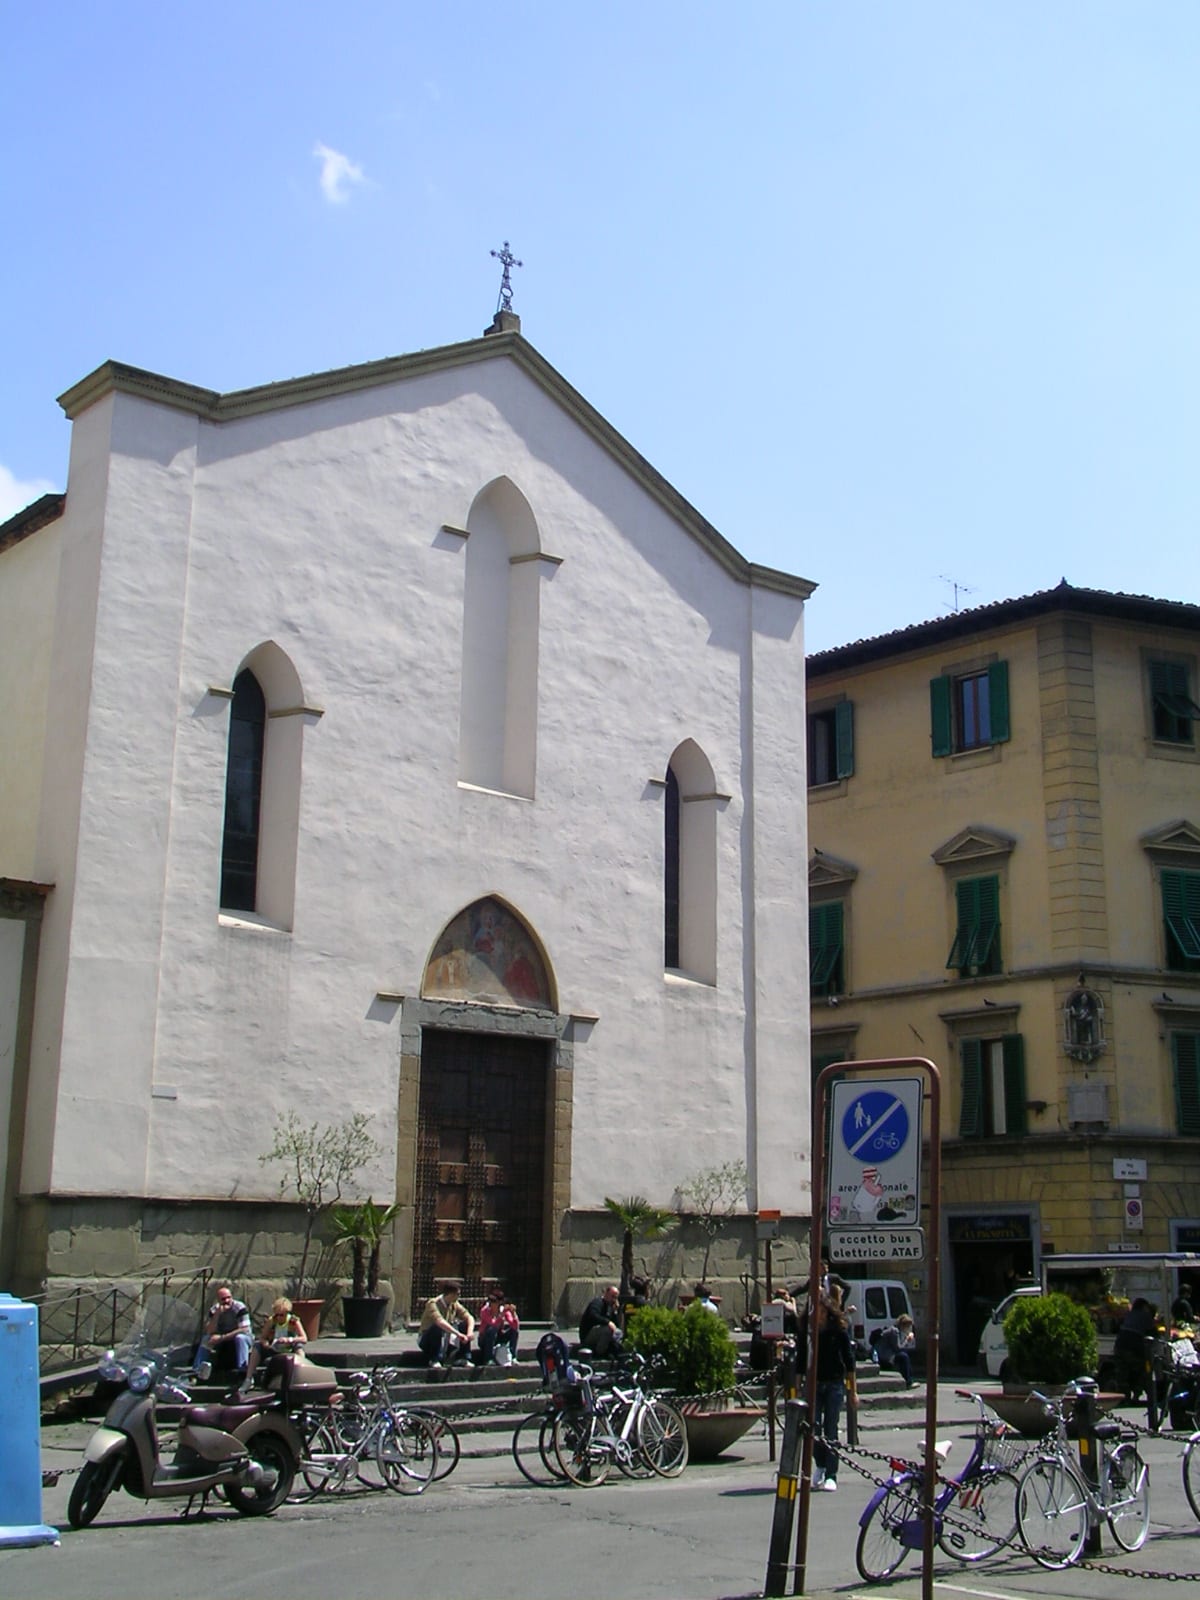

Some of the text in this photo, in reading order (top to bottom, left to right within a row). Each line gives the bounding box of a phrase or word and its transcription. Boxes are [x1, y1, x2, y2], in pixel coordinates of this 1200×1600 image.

[838, 1185, 858, 1193] area
[839, 1234, 911, 1244] eccetto bus
[833, 1247, 920, 1258] elettrico ATAF
